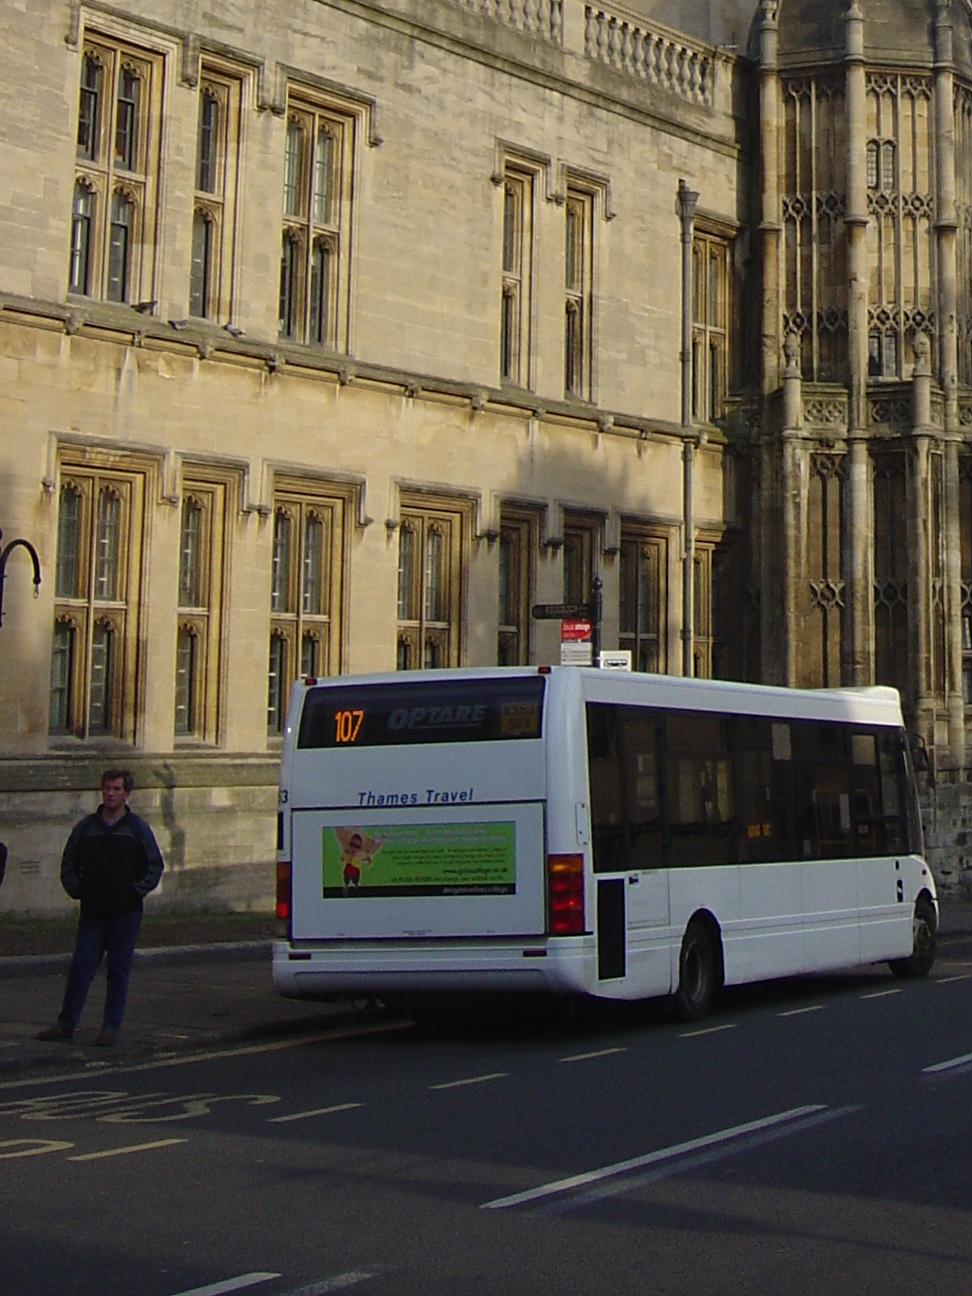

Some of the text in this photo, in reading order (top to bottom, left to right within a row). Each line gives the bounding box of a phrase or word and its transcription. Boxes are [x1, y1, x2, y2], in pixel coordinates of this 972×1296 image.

[335, 710, 364, 742] 107
[387, 705, 484, 730] OPTARE
[358, 788, 474, 805] Thames Travel
